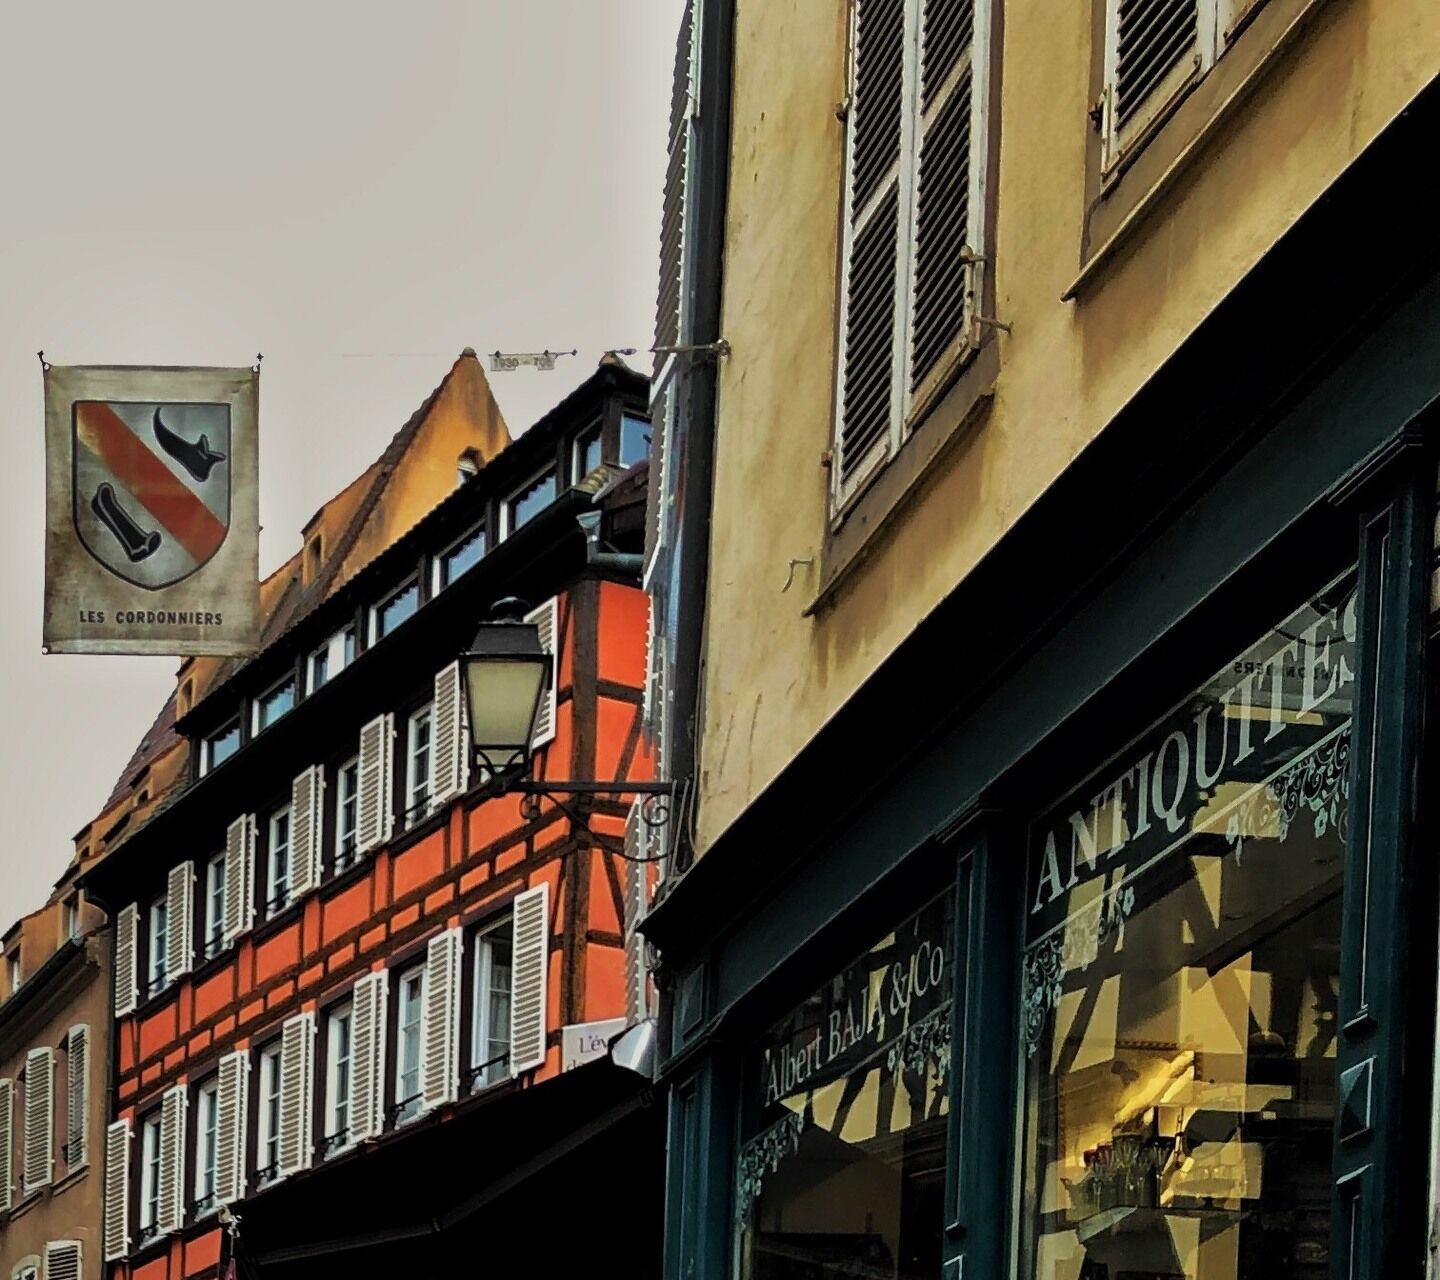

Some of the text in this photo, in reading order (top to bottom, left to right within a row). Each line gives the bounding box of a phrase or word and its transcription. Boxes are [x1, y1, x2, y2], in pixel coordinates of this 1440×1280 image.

[79, 610, 223, 626] LES CORDONNIERS
[765, 1027, 823, 1107] Albert
[889, 962, 908, 1016] &
[914, 940, 944, 997] Co
